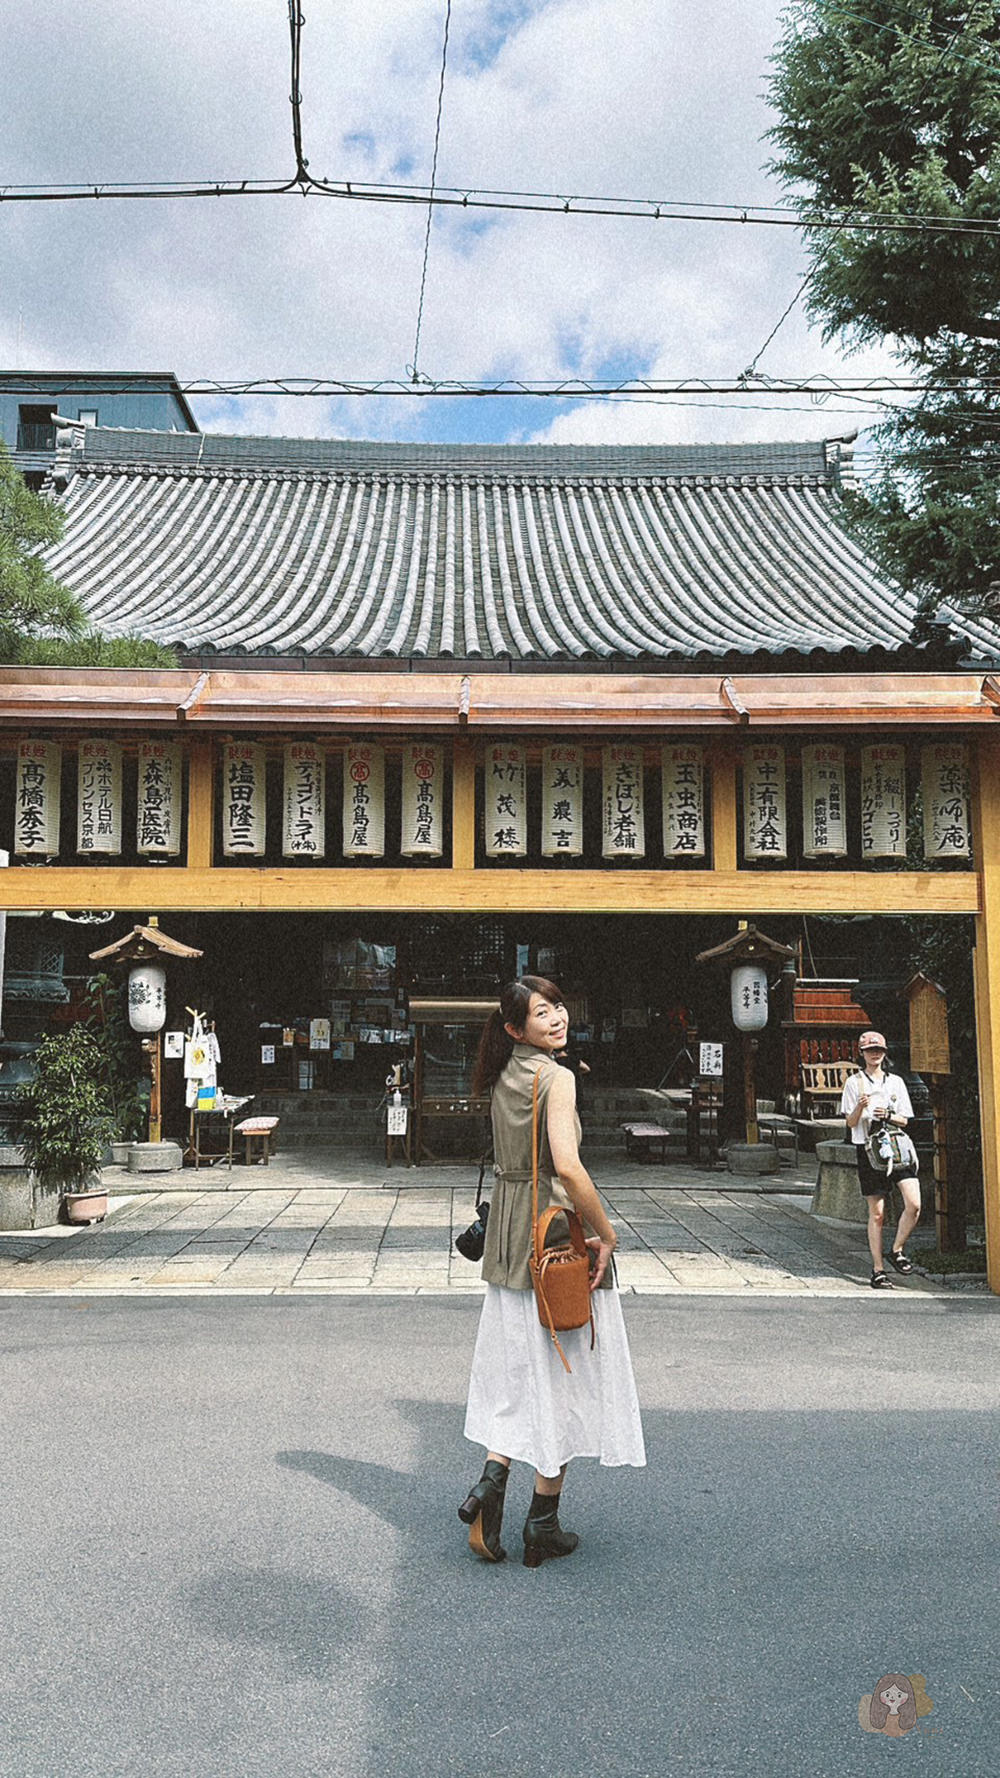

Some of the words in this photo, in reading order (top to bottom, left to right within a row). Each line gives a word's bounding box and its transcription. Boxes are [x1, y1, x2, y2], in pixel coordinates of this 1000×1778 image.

[81, 762, 95, 849] プリンセス京都
[97, 773, 113, 834] ホテル日航
[141, 760, 166, 846] 森島医院
[229, 761, 256, 848] 塩田隆三
[493, 763, 520, 849] 竹茂楼
[551, 768, 576, 847] 美濃吉
[673, 764, 698, 850] 玉虫商店
[755, 762, 780, 850] 中一有限会社
[936, 764, 964, 851] 薬師庵
